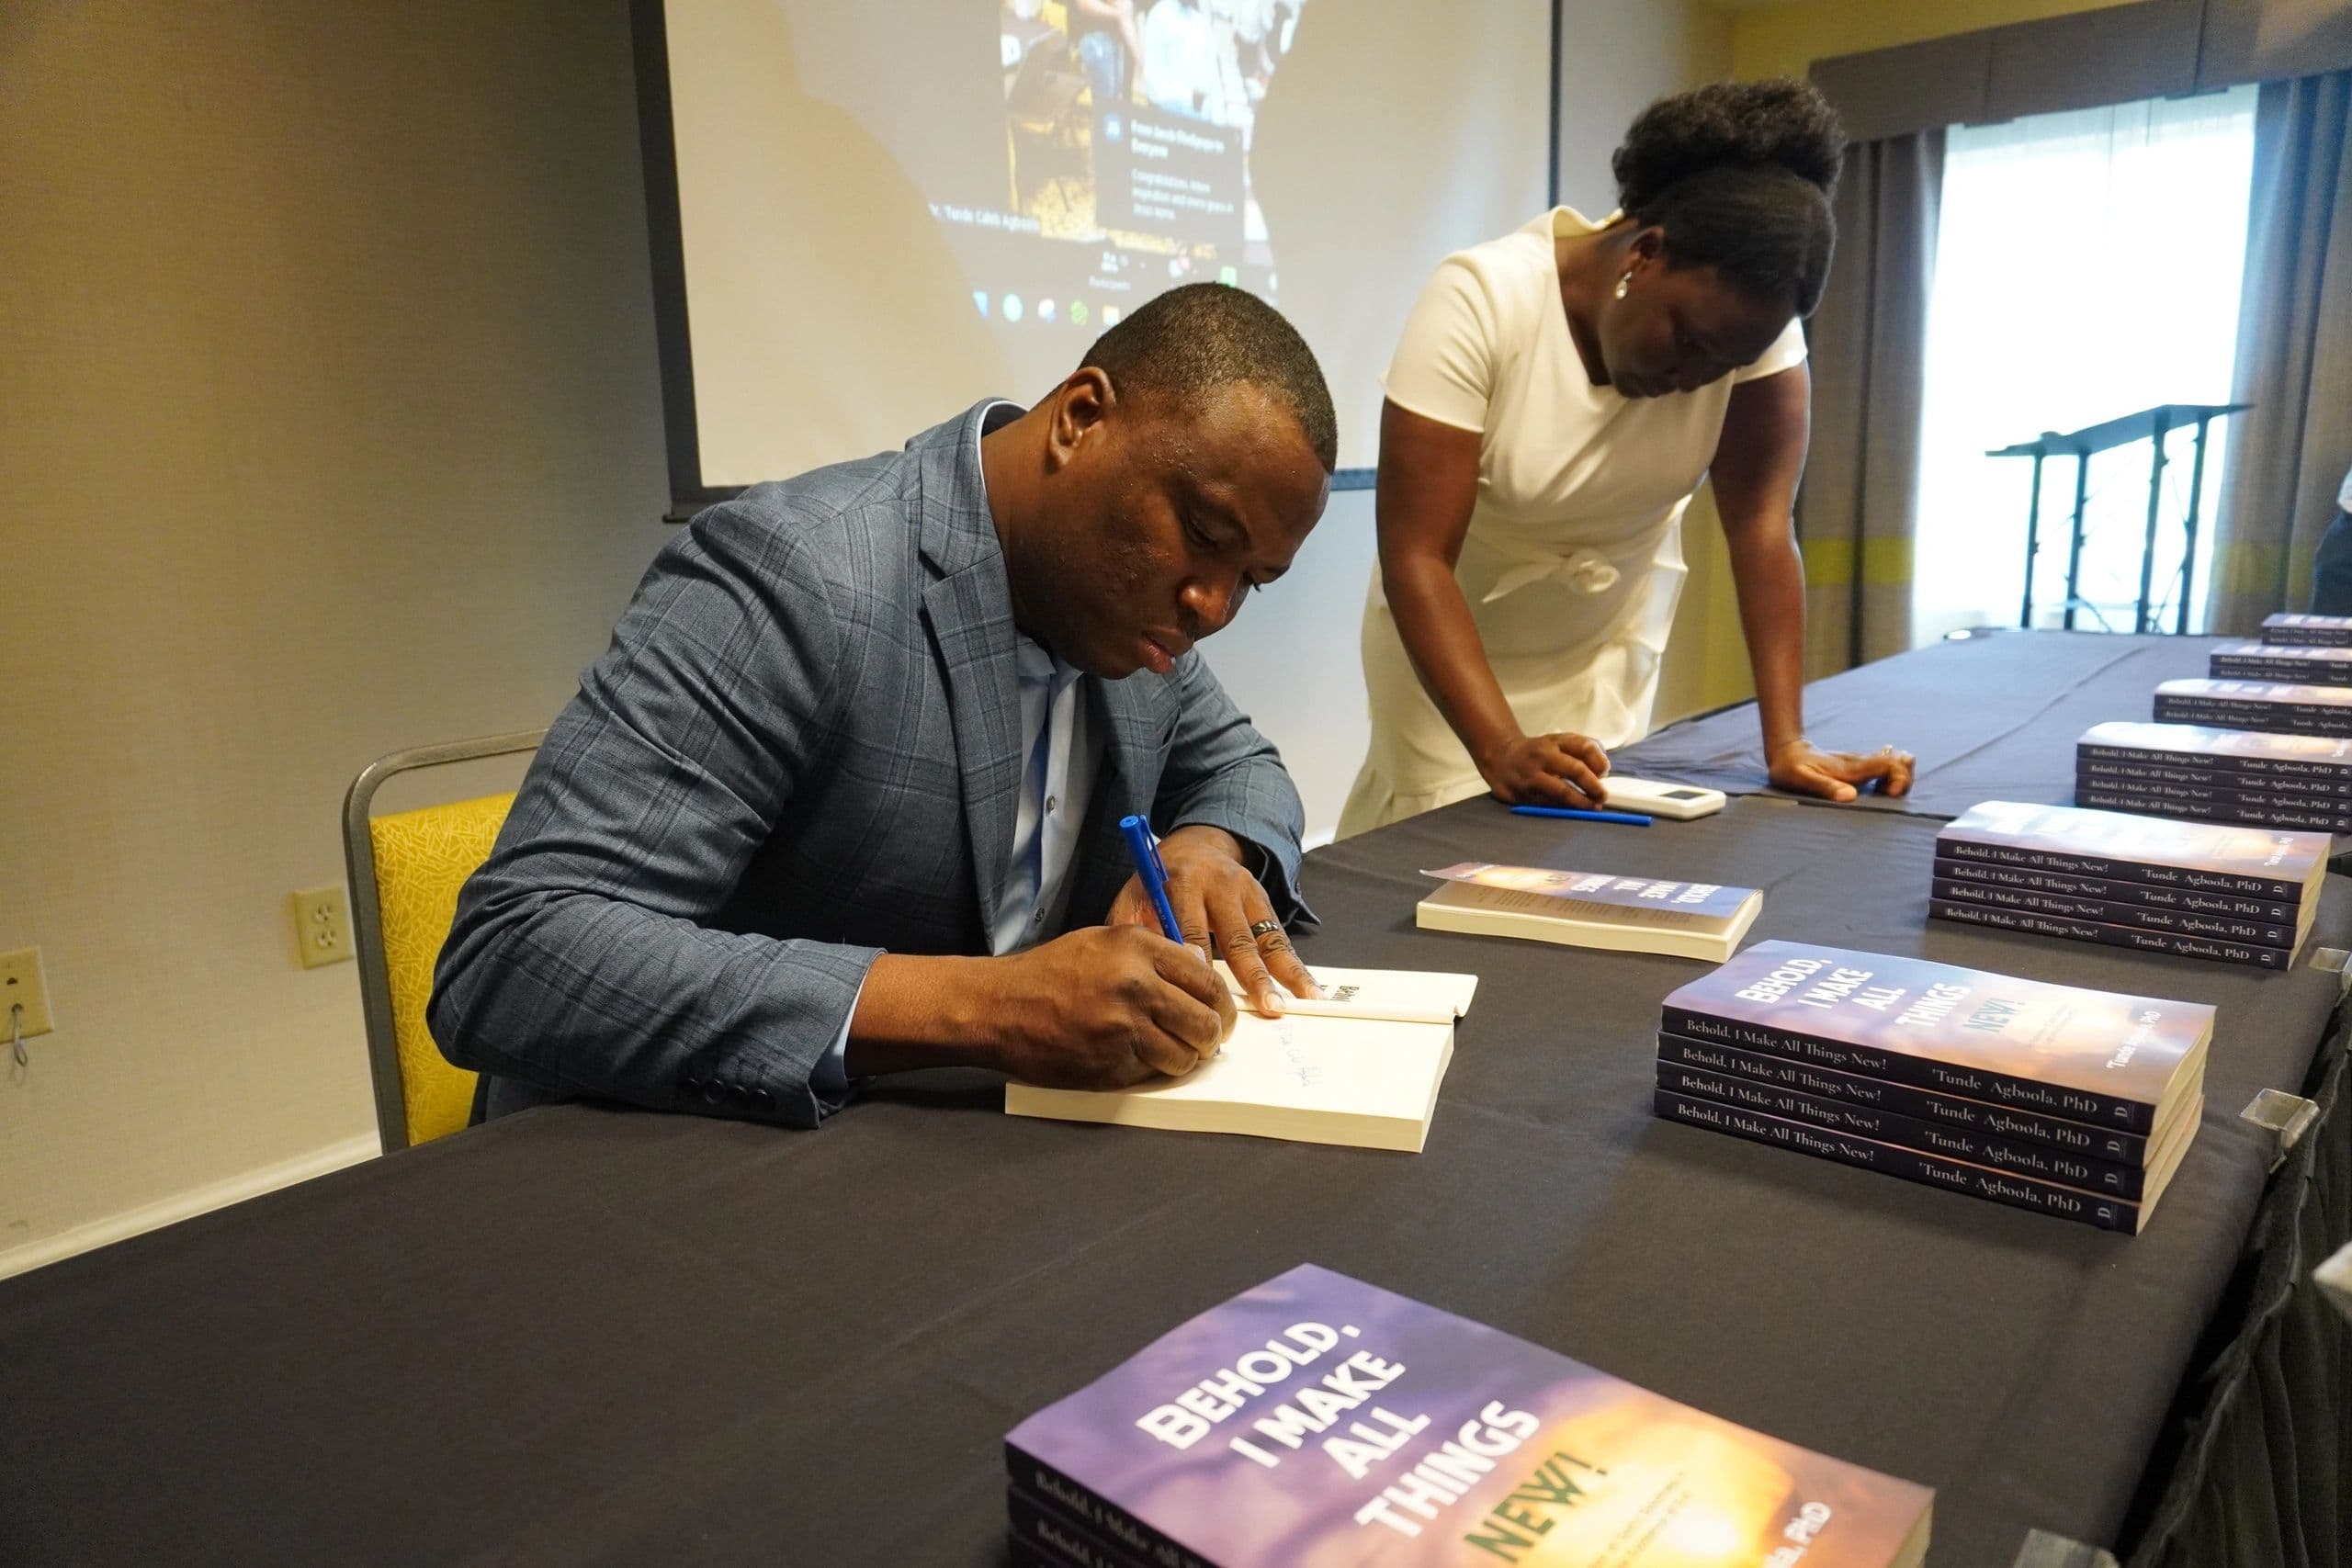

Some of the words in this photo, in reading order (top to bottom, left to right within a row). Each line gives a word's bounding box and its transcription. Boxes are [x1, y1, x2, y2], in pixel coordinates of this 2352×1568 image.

[1998, 873, 2025, 884] Make
[2027, 876, 2041, 886] All
[2080, 883, 2108, 895] New!
[2000, 852, 2026, 863] Make
[2029, 854, 2043, 864] All
[2082, 862, 2109, 873] New!
[1990, 914, 2017, 926] Make
[2019, 919, 2034, 928] All
[2071, 926, 2098, 937] New!
[1996, 892, 2021, 905] Make
[2024, 897, 2039, 907] All
[2076, 904, 2104, 916] New!
[1735, 959, 1832, 1003] BEHOLD,
[1804, 968, 1874, 1003] MAKE
[1852, 987, 1906, 1010] ALL
[1798, 999, 1832, 1009] I
[1894, 983, 1972, 1027] THINGS
[1962, 998, 2025, 1032] NEW!
[1736, 1029, 1740, 1040] I
[1745, 1031, 1777, 1048] Make
[1781, 1039, 1800, 1053] All
[1804, 1042, 1847, 1064] Things
[1851, 1051, 1887, 1069] New!
[2064, 1095, 2098, 1113] PhD
[1731, 1058, 1736, 1069] I
[1739, 1059, 1773, 1077] Make
[1777, 1069, 1795, 1082] All
[1799, 1072, 1842, 1095] Things
[1846, 1083, 1882, 1101] New!
[2056, 1128, 2091, 1146] PhD
[1730, 1086, 1734, 1097] I
[1737, 1088, 1771, 1106] Make
[1775, 1098, 1794, 1111] All
[1797, 1101, 1840, 1124] Things
[1844, 1111, 1879, 1132] New!
[2054, 1160, 2088, 1179] PhD
[1725, 1115, 1729, 1126] I
[1733, 1115, 1766, 1135] Make
[1770, 1126, 1789, 1140] All
[1792, 1130, 1836, 1154] Things
[1839, 1143, 1875, 1161] New!
[2047, 1193, 2081, 1213] PhD
[1135, 1323, 1360, 1450] BEHOLD,
[1253, 1350, 1406, 1450] MAKE
[1229, 1437, 1281, 1468] I
[1322, 1406, 1431, 1480] ALL
[1354, 1400, 1540, 1538] THINGS
[1464, 1451, 1607, 1563] NEW!
